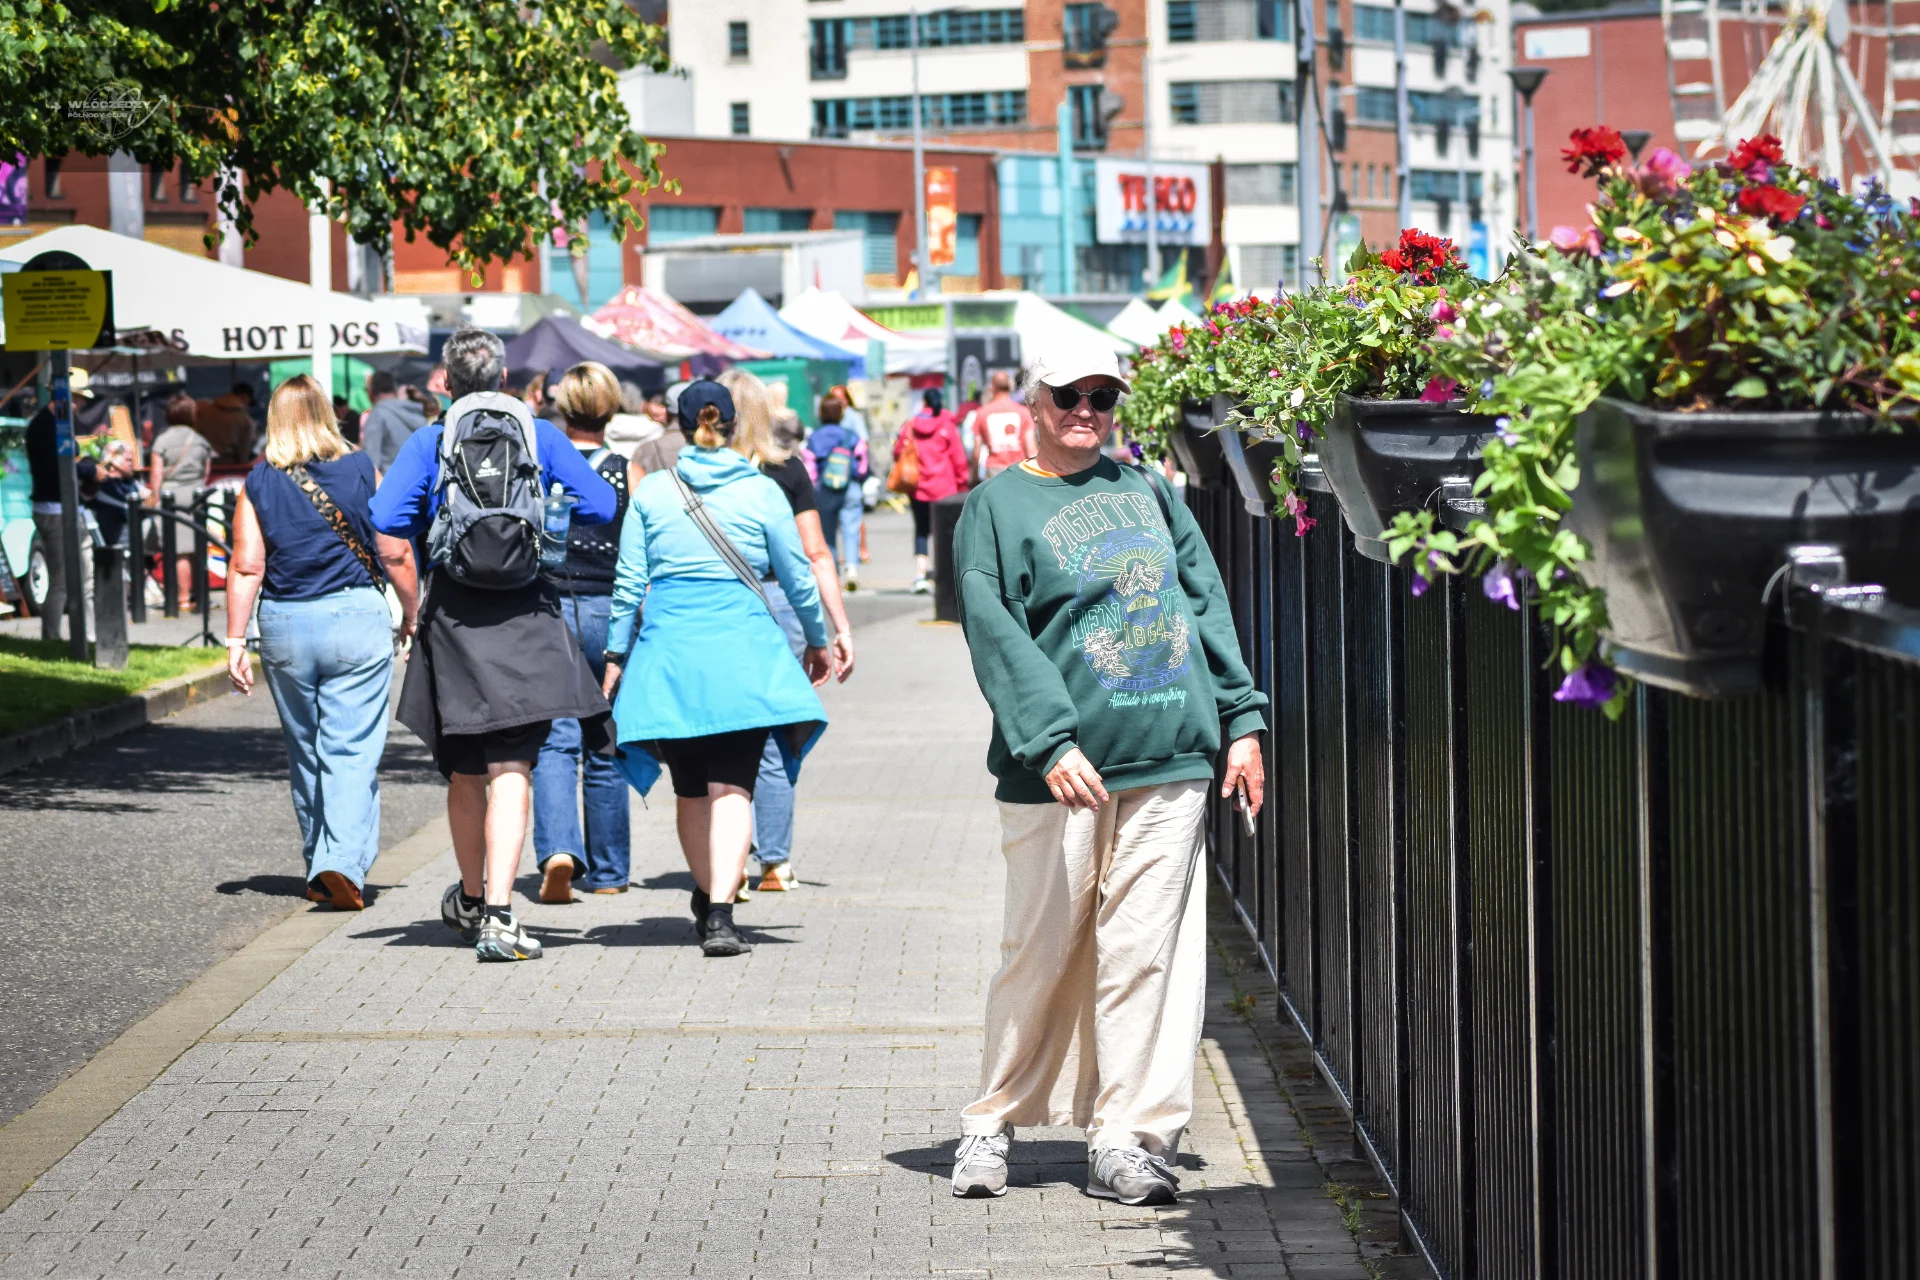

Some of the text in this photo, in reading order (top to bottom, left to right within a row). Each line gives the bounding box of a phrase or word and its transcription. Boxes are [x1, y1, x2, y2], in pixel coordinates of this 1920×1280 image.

[222, 325, 287, 352] HOT
[1123, 612, 1168, 650] 1864
[1108, 685, 1187, 711] Attitude is everything
